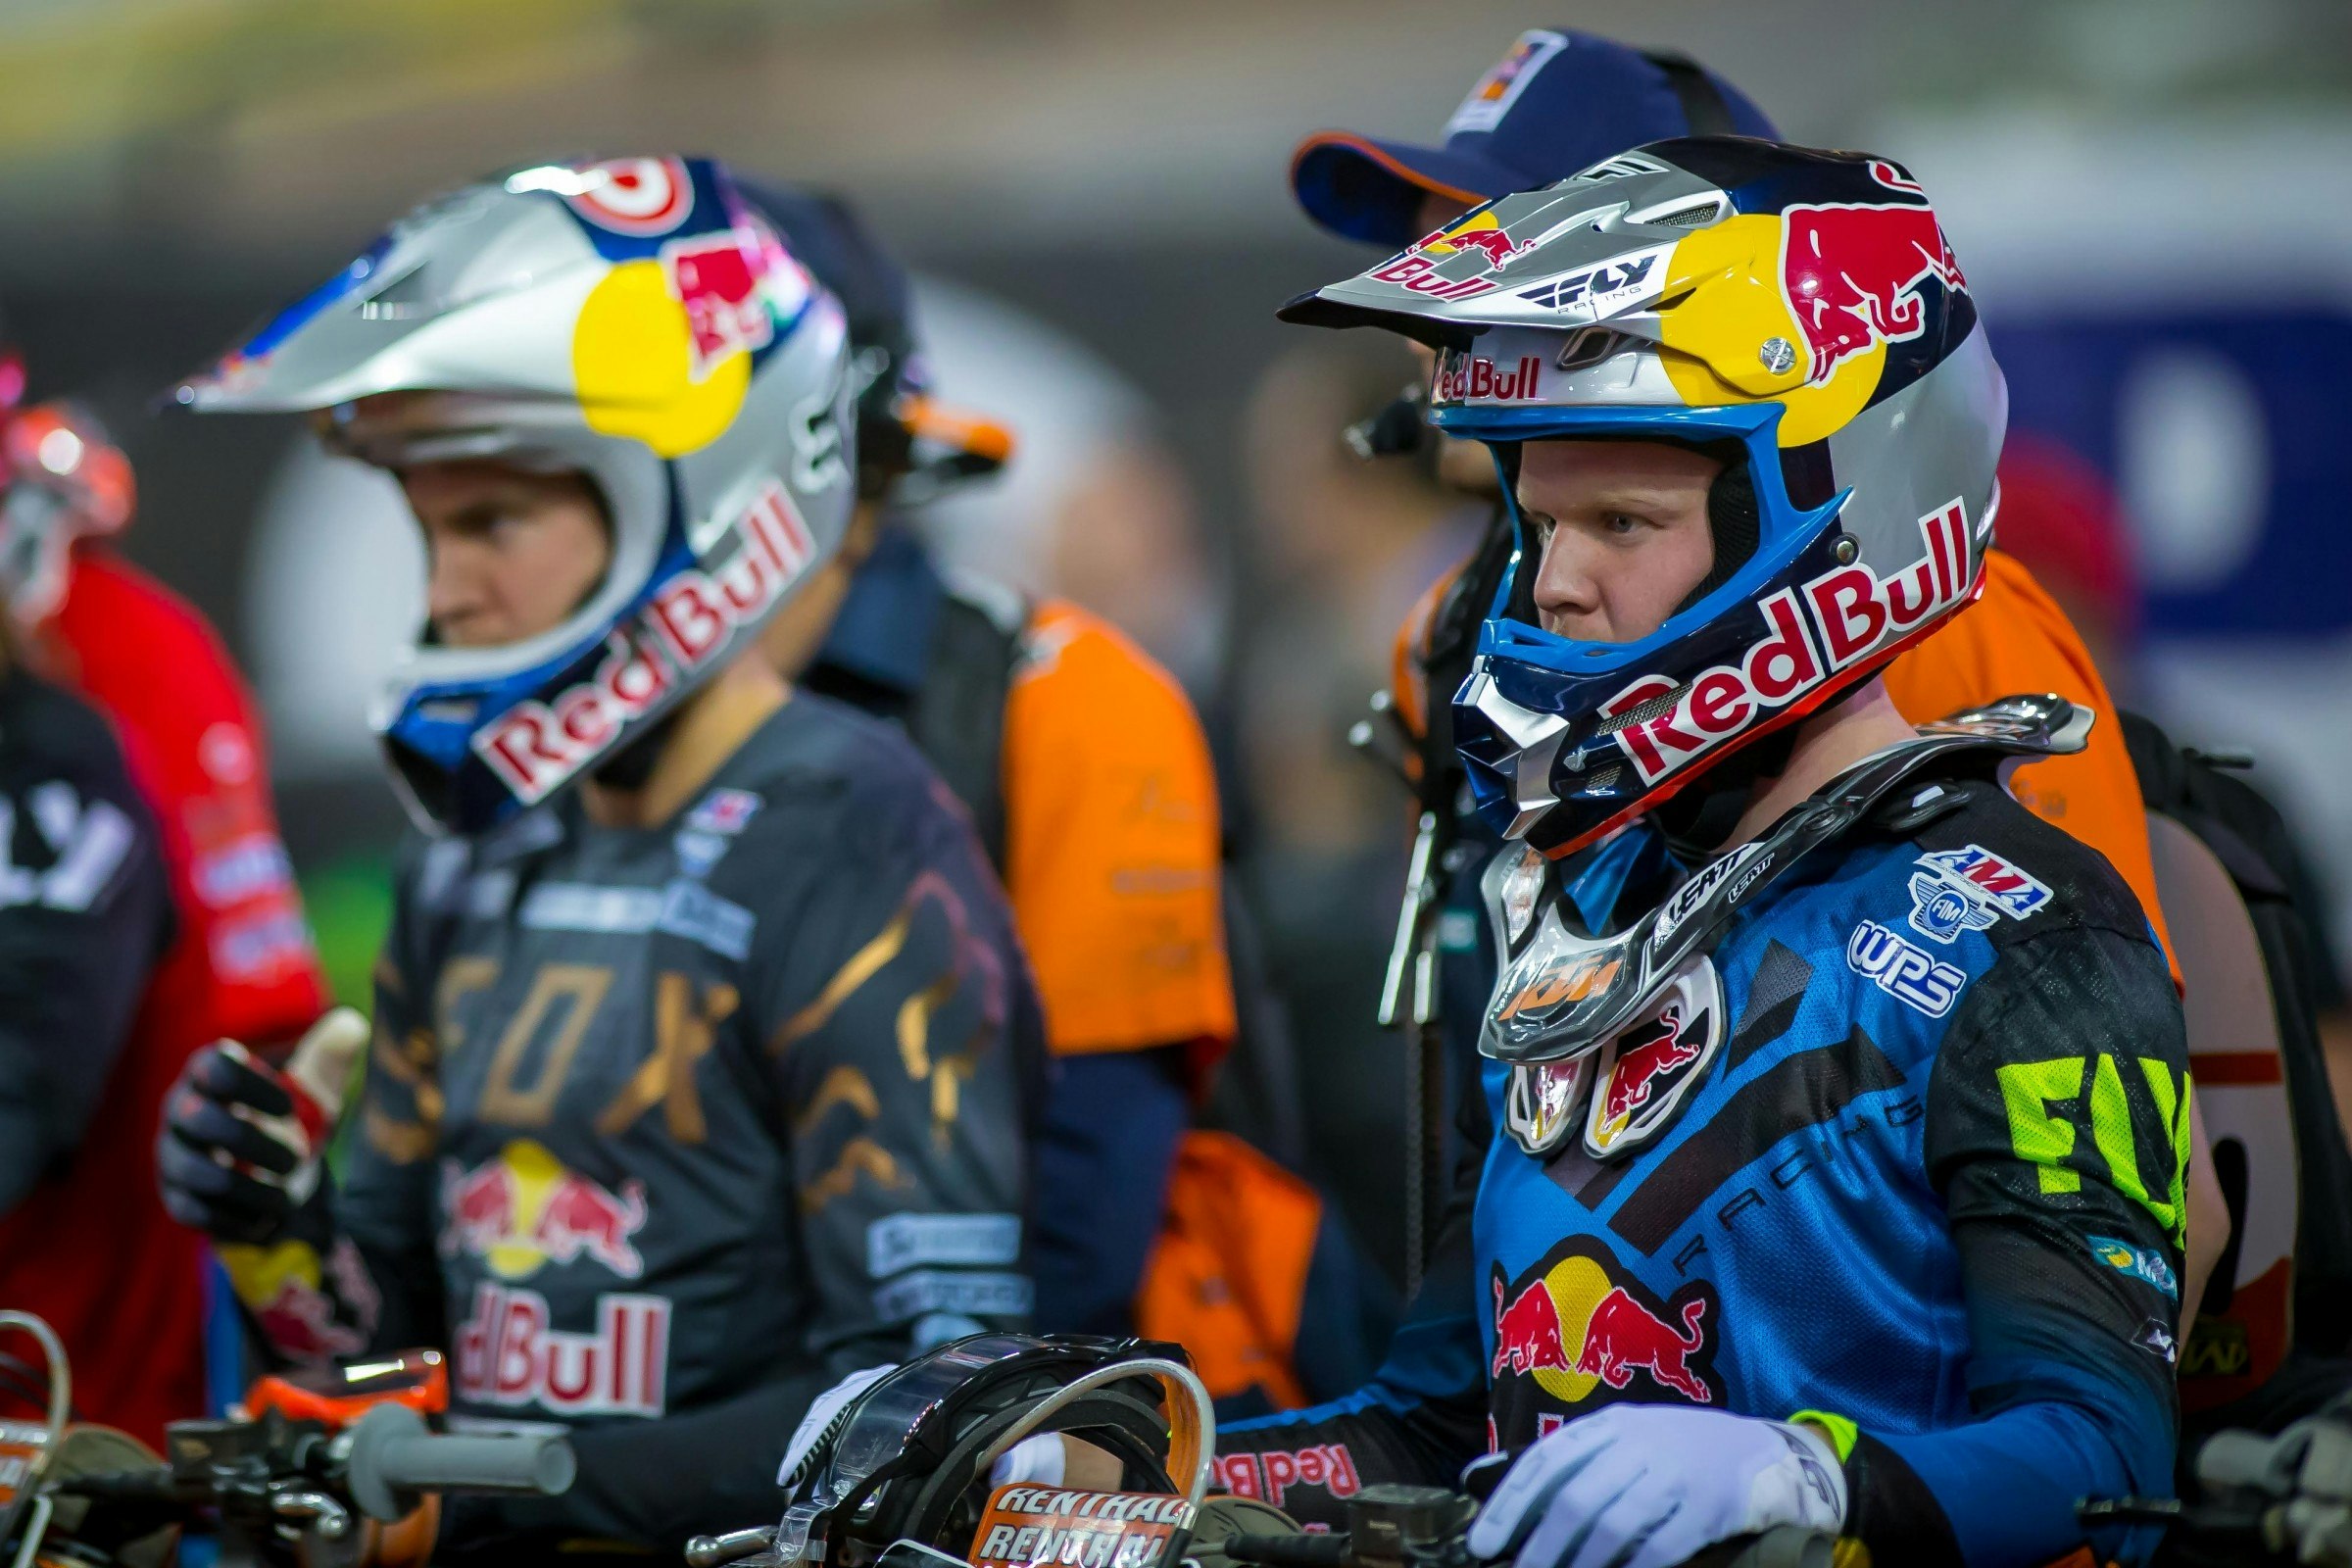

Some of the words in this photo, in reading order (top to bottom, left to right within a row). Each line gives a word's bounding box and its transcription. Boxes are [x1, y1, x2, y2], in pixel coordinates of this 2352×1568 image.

[1372, 257, 1502, 303] Bull
[1516, 254, 1658, 309] FLY
[1470, 357, 1542, 400] Bull
[489, 620, 672, 790] Red
[649, 490, 813, 663] Bull
[1605, 594, 1820, 782] Red
[1810, 503, 1969, 665] Bull
[1668, 844, 1751, 927] LEATT
[1728, 852, 1776, 905] LEATT
[1930, 848, 2048, 914] AMA
[1932, 899, 1962, 922] FIM
[1850, 924, 1965, 1012] WPS
[996, 1487, 1189, 1525] RENTHAL
